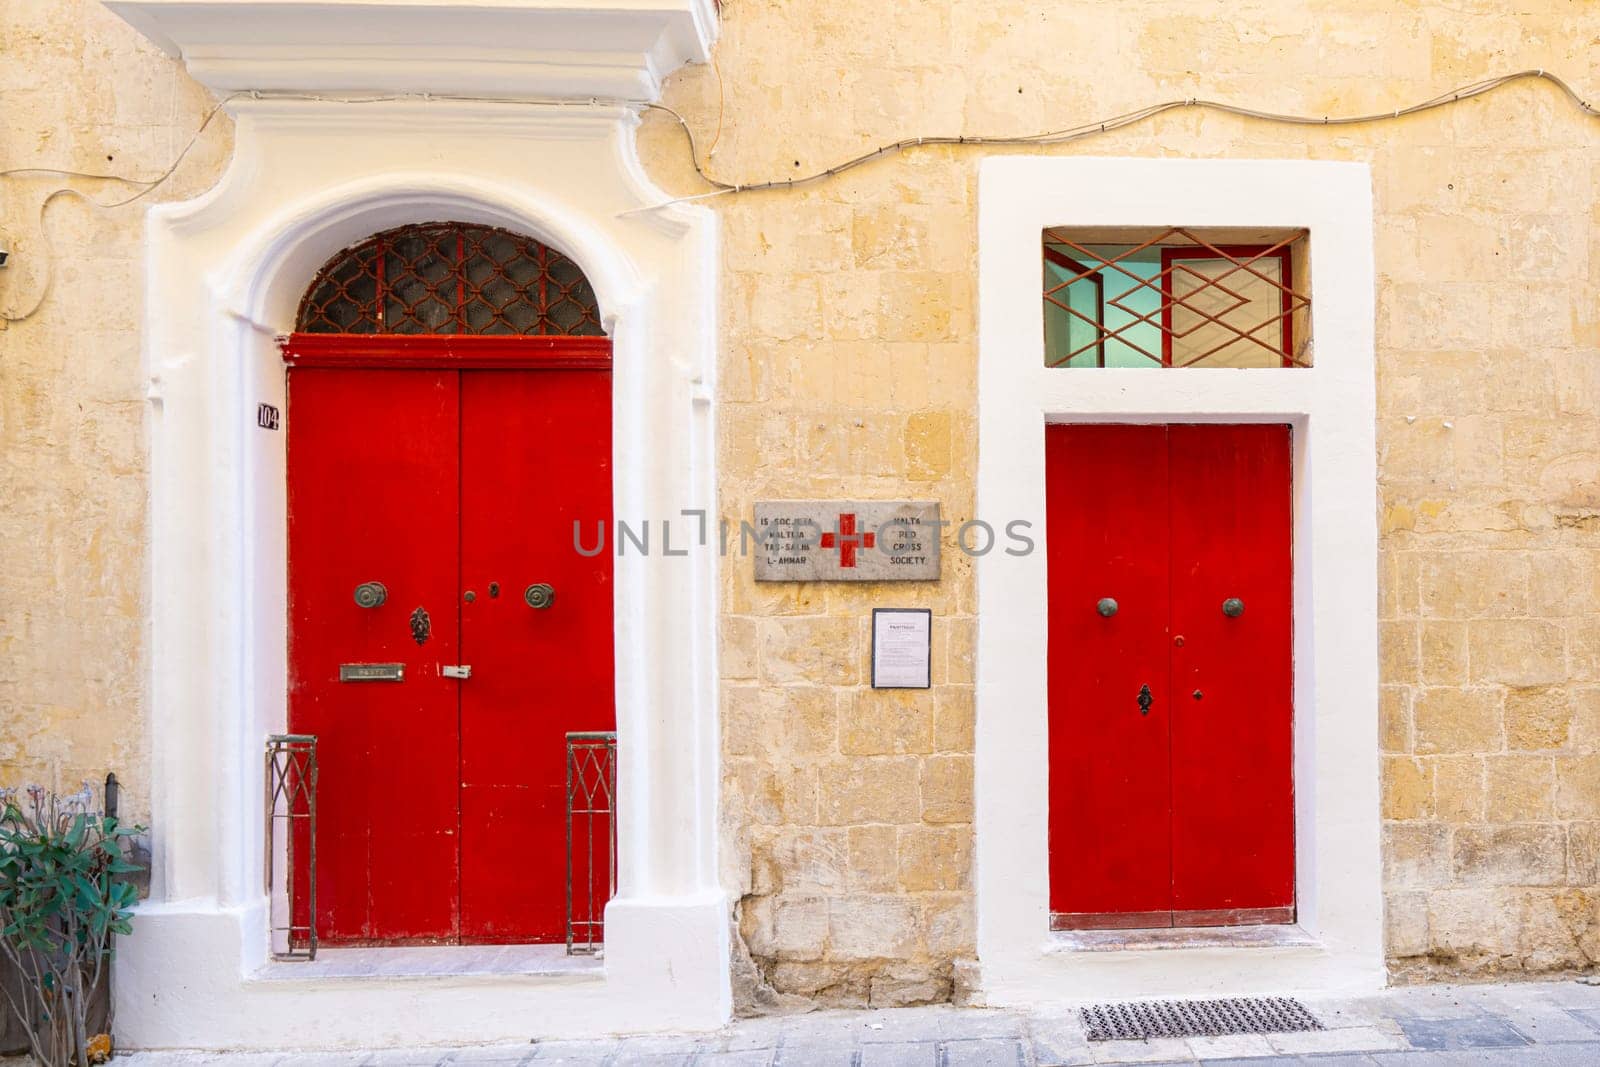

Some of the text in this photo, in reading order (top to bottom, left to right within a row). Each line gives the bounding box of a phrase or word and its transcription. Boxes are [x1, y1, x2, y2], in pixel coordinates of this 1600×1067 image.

[259, 405, 279, 429] 104
[894, 517, 921, 525] MALTA
[898, 530, 917, 539] RED
[893, 543, 922, 551] CROSS
[889, 555, 926, 565] SOCIETY
